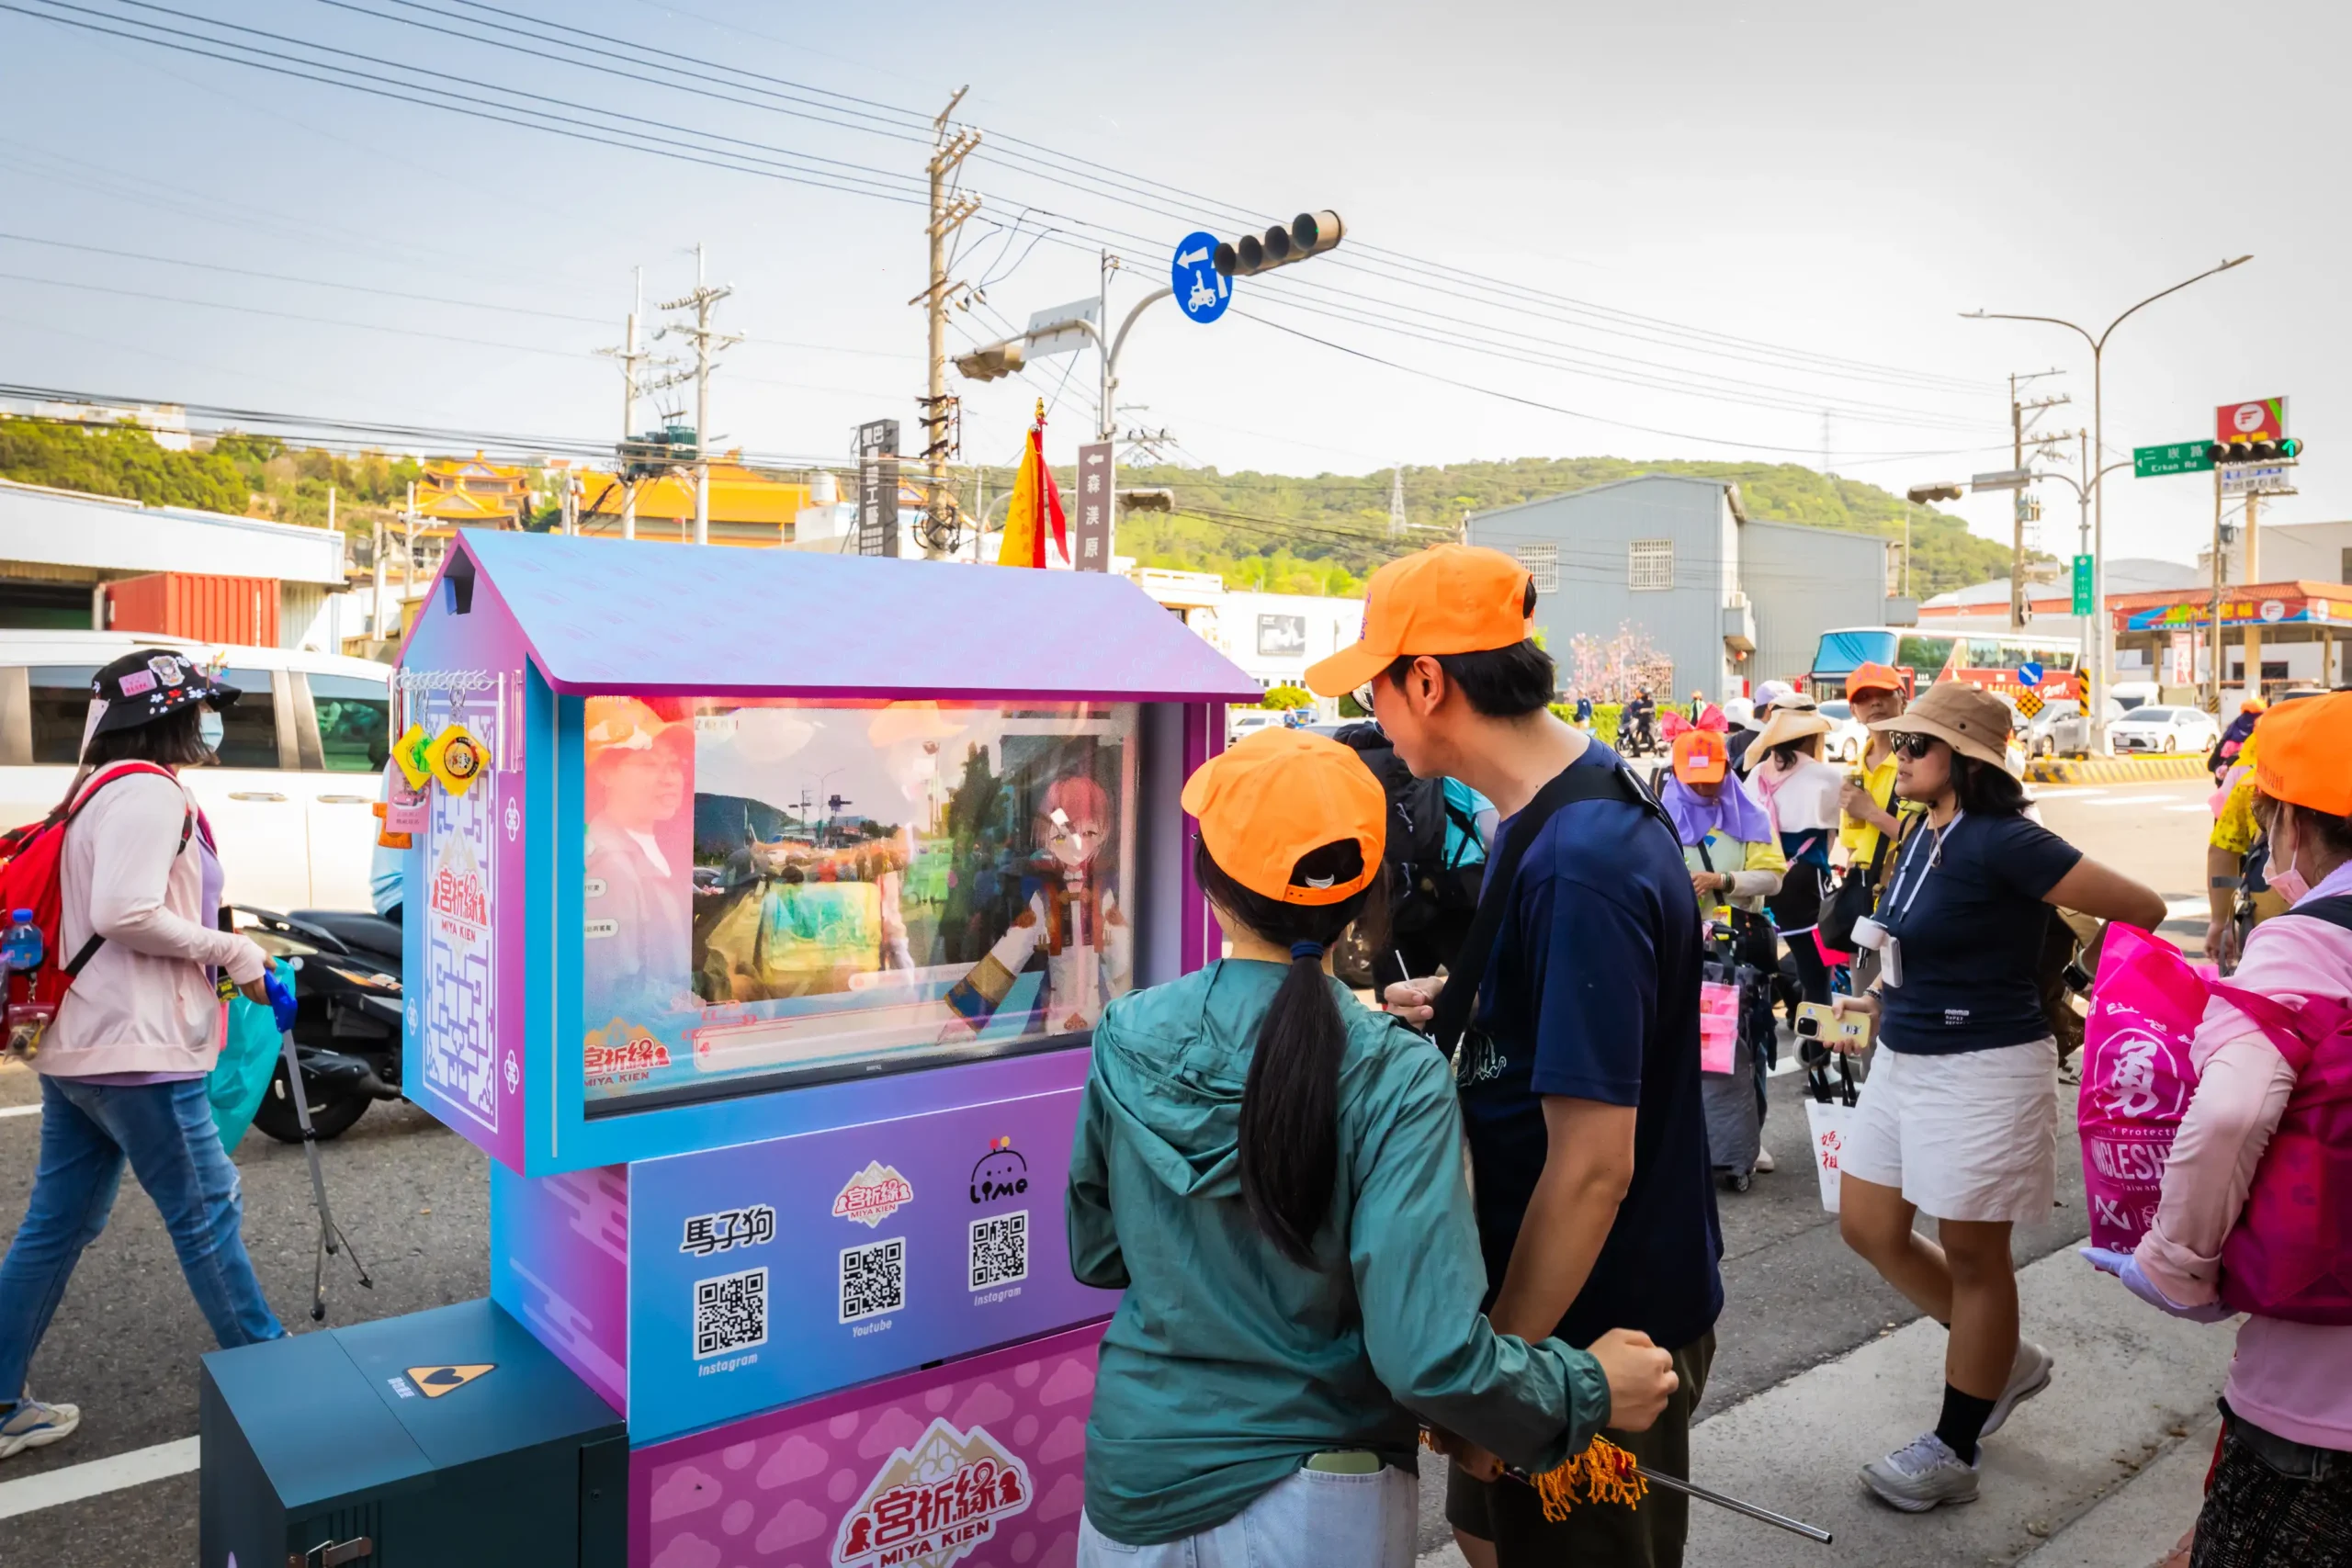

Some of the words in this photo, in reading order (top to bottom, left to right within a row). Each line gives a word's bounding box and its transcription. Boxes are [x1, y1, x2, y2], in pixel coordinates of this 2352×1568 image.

[441, 919, 458, 936] MIYA
[459, 928, 477, 943] KIEN
[619, 1071, 650, 1083] KIEN
[1820, 1131, 1841, 1171] 媽祖
[850, 1208, 873, 1220] MIYA
[874, 1202, 897, 1215] KIEN
[974, 1285, 1022, 1307] Instagram
[852, 1318, 893, 1338] Youtube
[697, 1352, 759, 1377] Instagram
[874, 1461, 997, 1547] 宮祈緣
[879, 1540, 933, 1568] MIYA
[941, 1519, 989, 1548] KIEN
